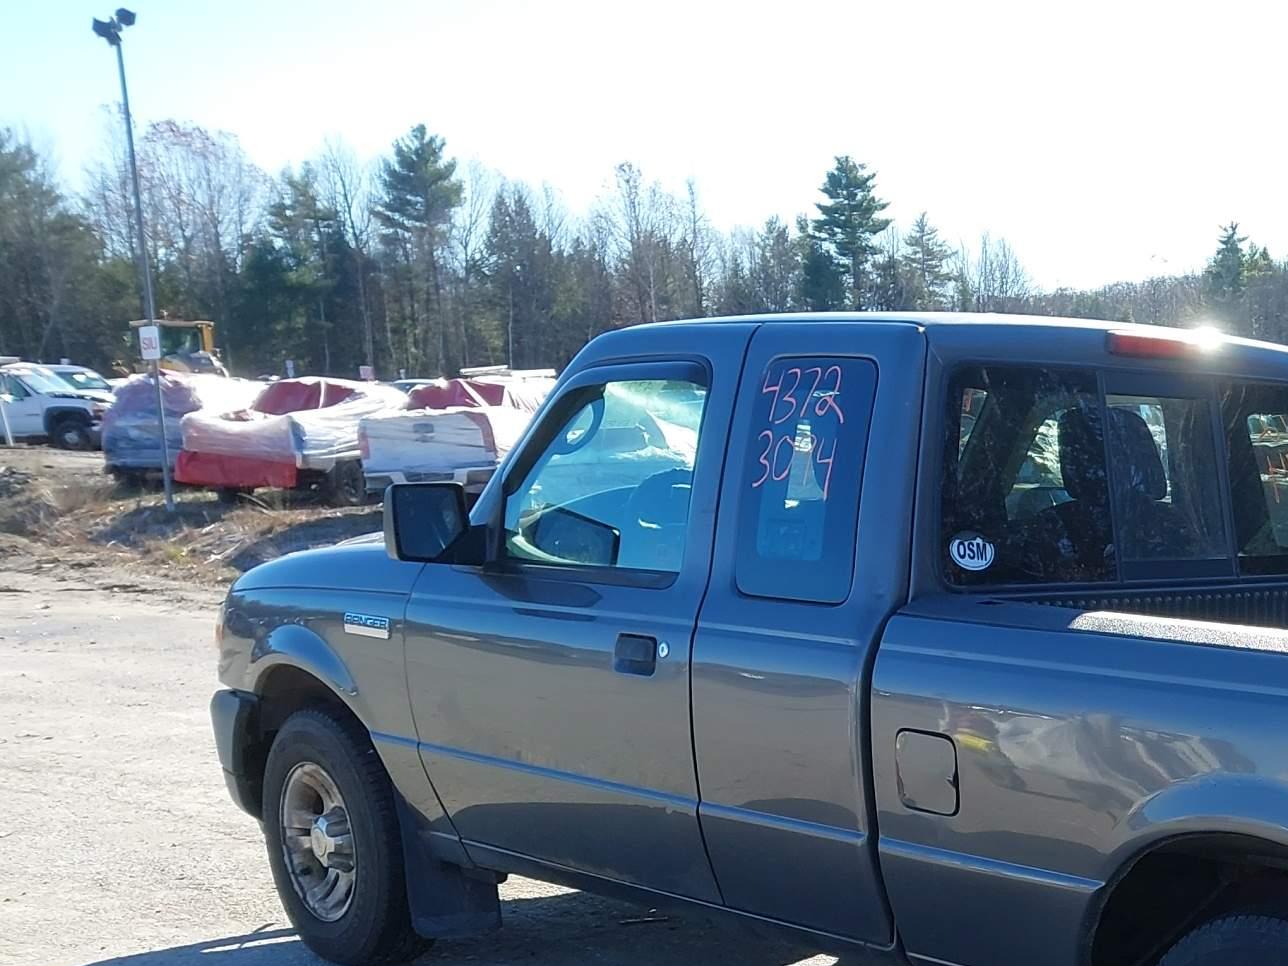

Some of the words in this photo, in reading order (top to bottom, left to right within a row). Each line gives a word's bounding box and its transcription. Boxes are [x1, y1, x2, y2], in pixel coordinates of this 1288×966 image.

[761, 366, 844, 425] 4372
[752, 430, 837, 502] 3094
[957, 541, 987, 561] OSM
